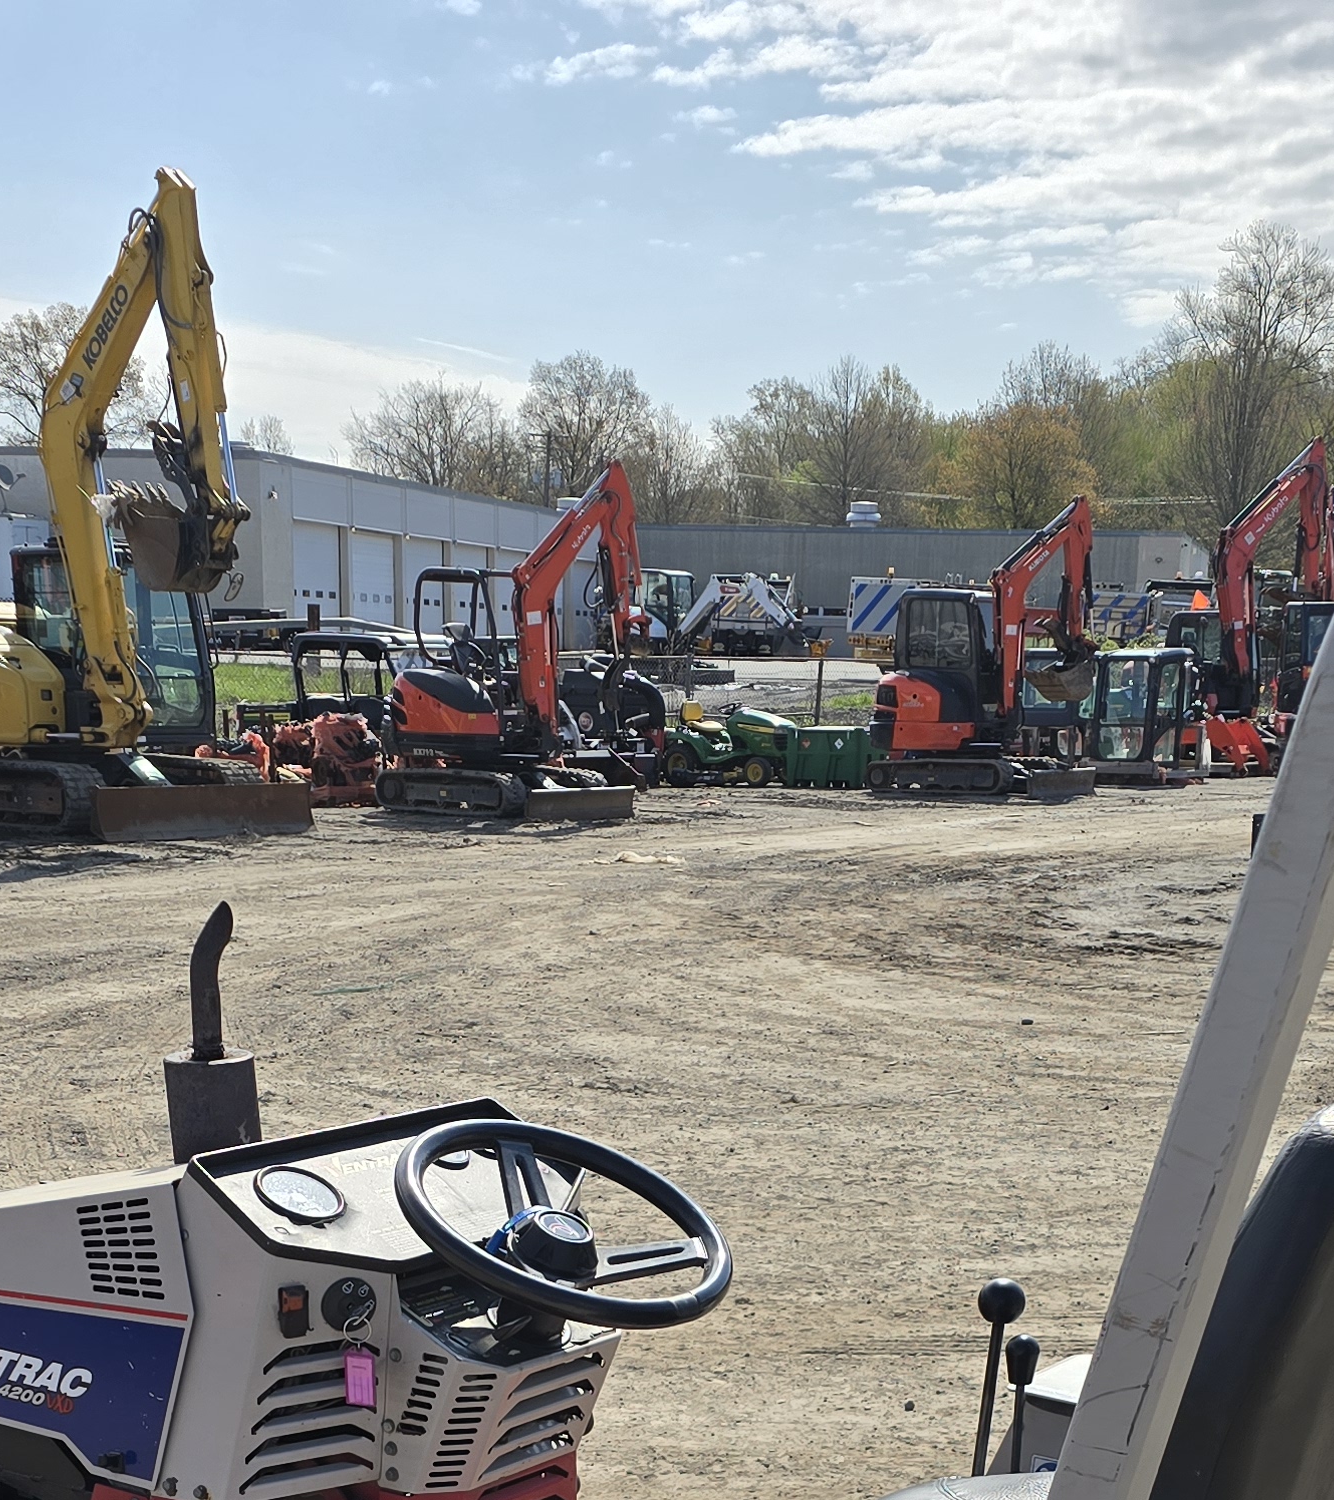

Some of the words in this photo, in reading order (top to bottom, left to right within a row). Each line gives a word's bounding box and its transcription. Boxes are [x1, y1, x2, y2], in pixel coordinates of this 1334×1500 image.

[82, 284, 128, 371] KOBELCO
[1263, 495, 1289, 522] Kubota
[316, 1153, 401, 1178] VENTRA
